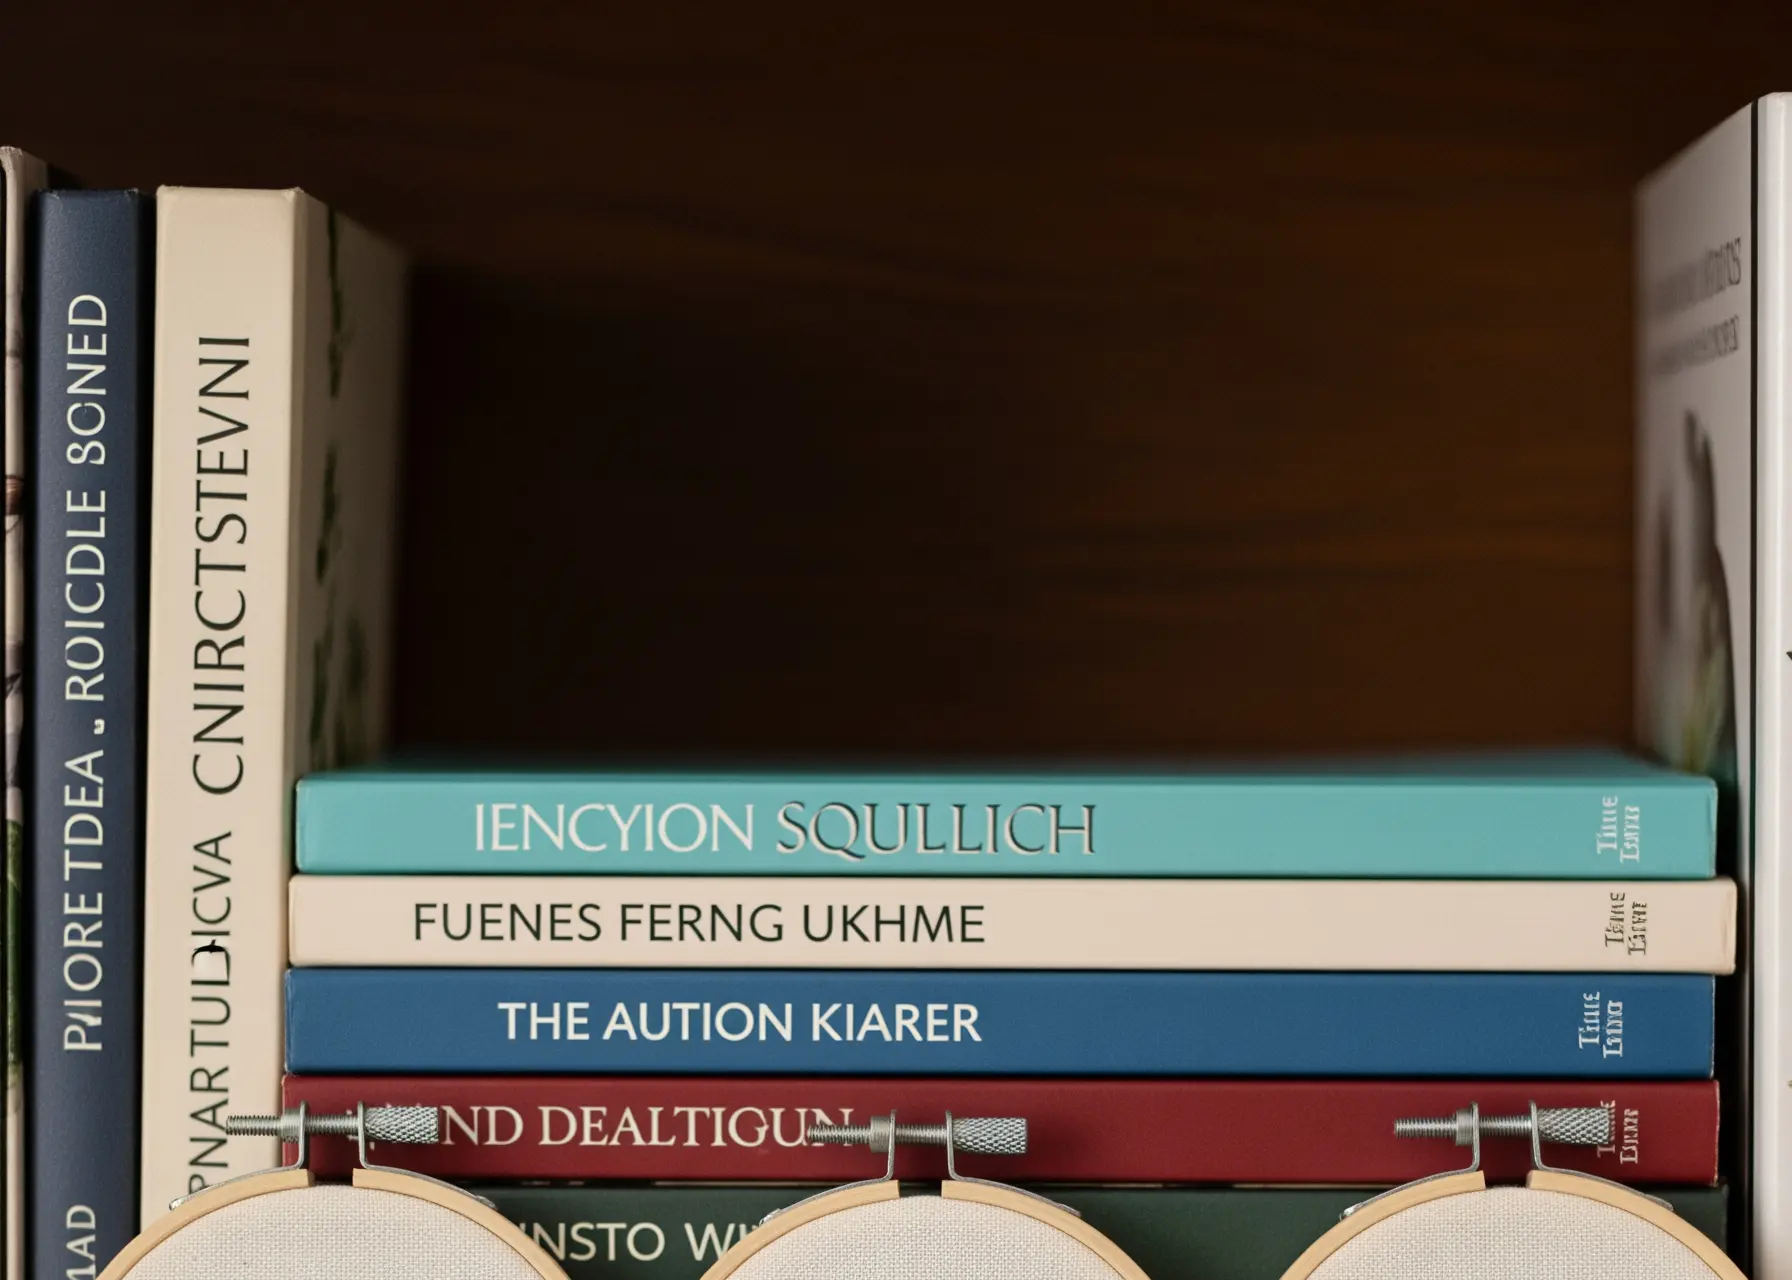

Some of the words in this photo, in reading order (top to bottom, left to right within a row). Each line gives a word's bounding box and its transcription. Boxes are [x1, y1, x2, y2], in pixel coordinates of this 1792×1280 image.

[65, 490, 106, 701] ROICDLE
[776, 801, 1097, 861] SQULLICH
[414, 903, 602, 942] FUENES
[620, 903, 784, 942] FERNG
[803, 904, 986, 943] UKHME
[497, 1002, 590, 1040] THE
[602, 1002, 792, 1042] AUTION
[812, 1003, 982, 1042] KIARER
[520, 1222, 666, 1261] NSTO
